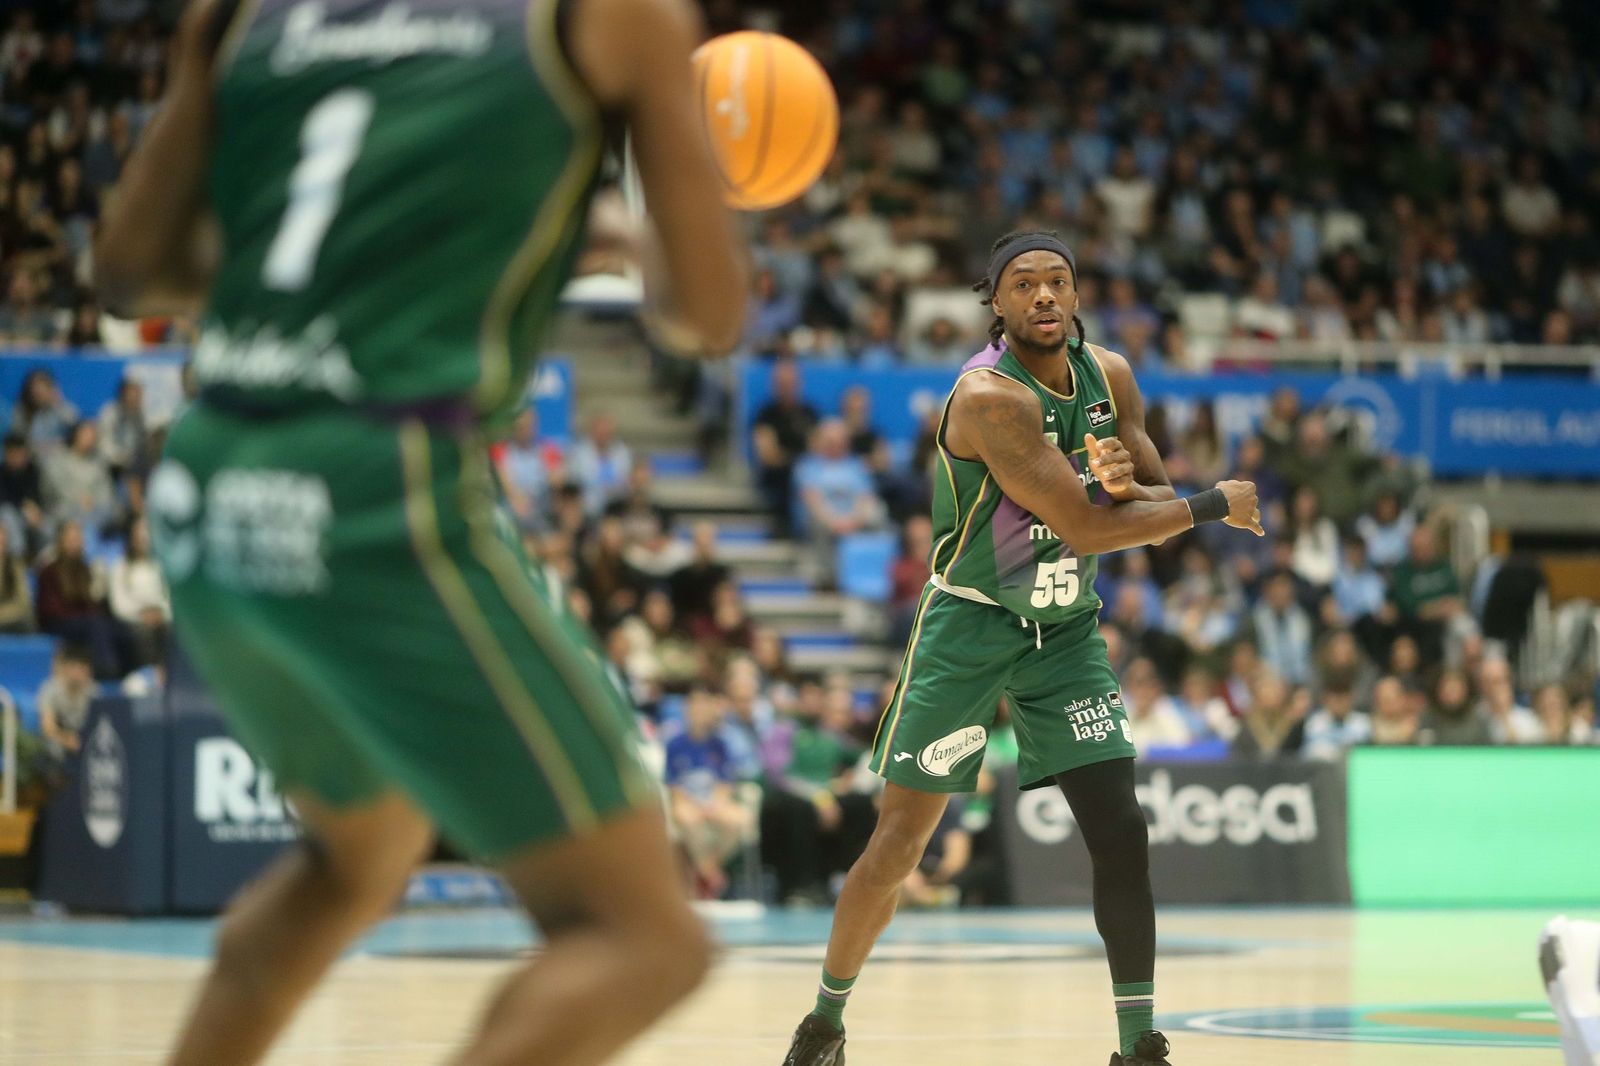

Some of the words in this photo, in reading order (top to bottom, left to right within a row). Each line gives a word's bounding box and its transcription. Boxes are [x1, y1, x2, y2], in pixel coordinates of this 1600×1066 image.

[262, 88, 375, 290] 1
[1031, 558, 1079, 608] 55
[1063, 697, 1092, 713] sabor
[1074, 698, 1111, 725] má
[1071, 719, 1117, 742] laga
[1017, 768, 1317, 845] edesa
